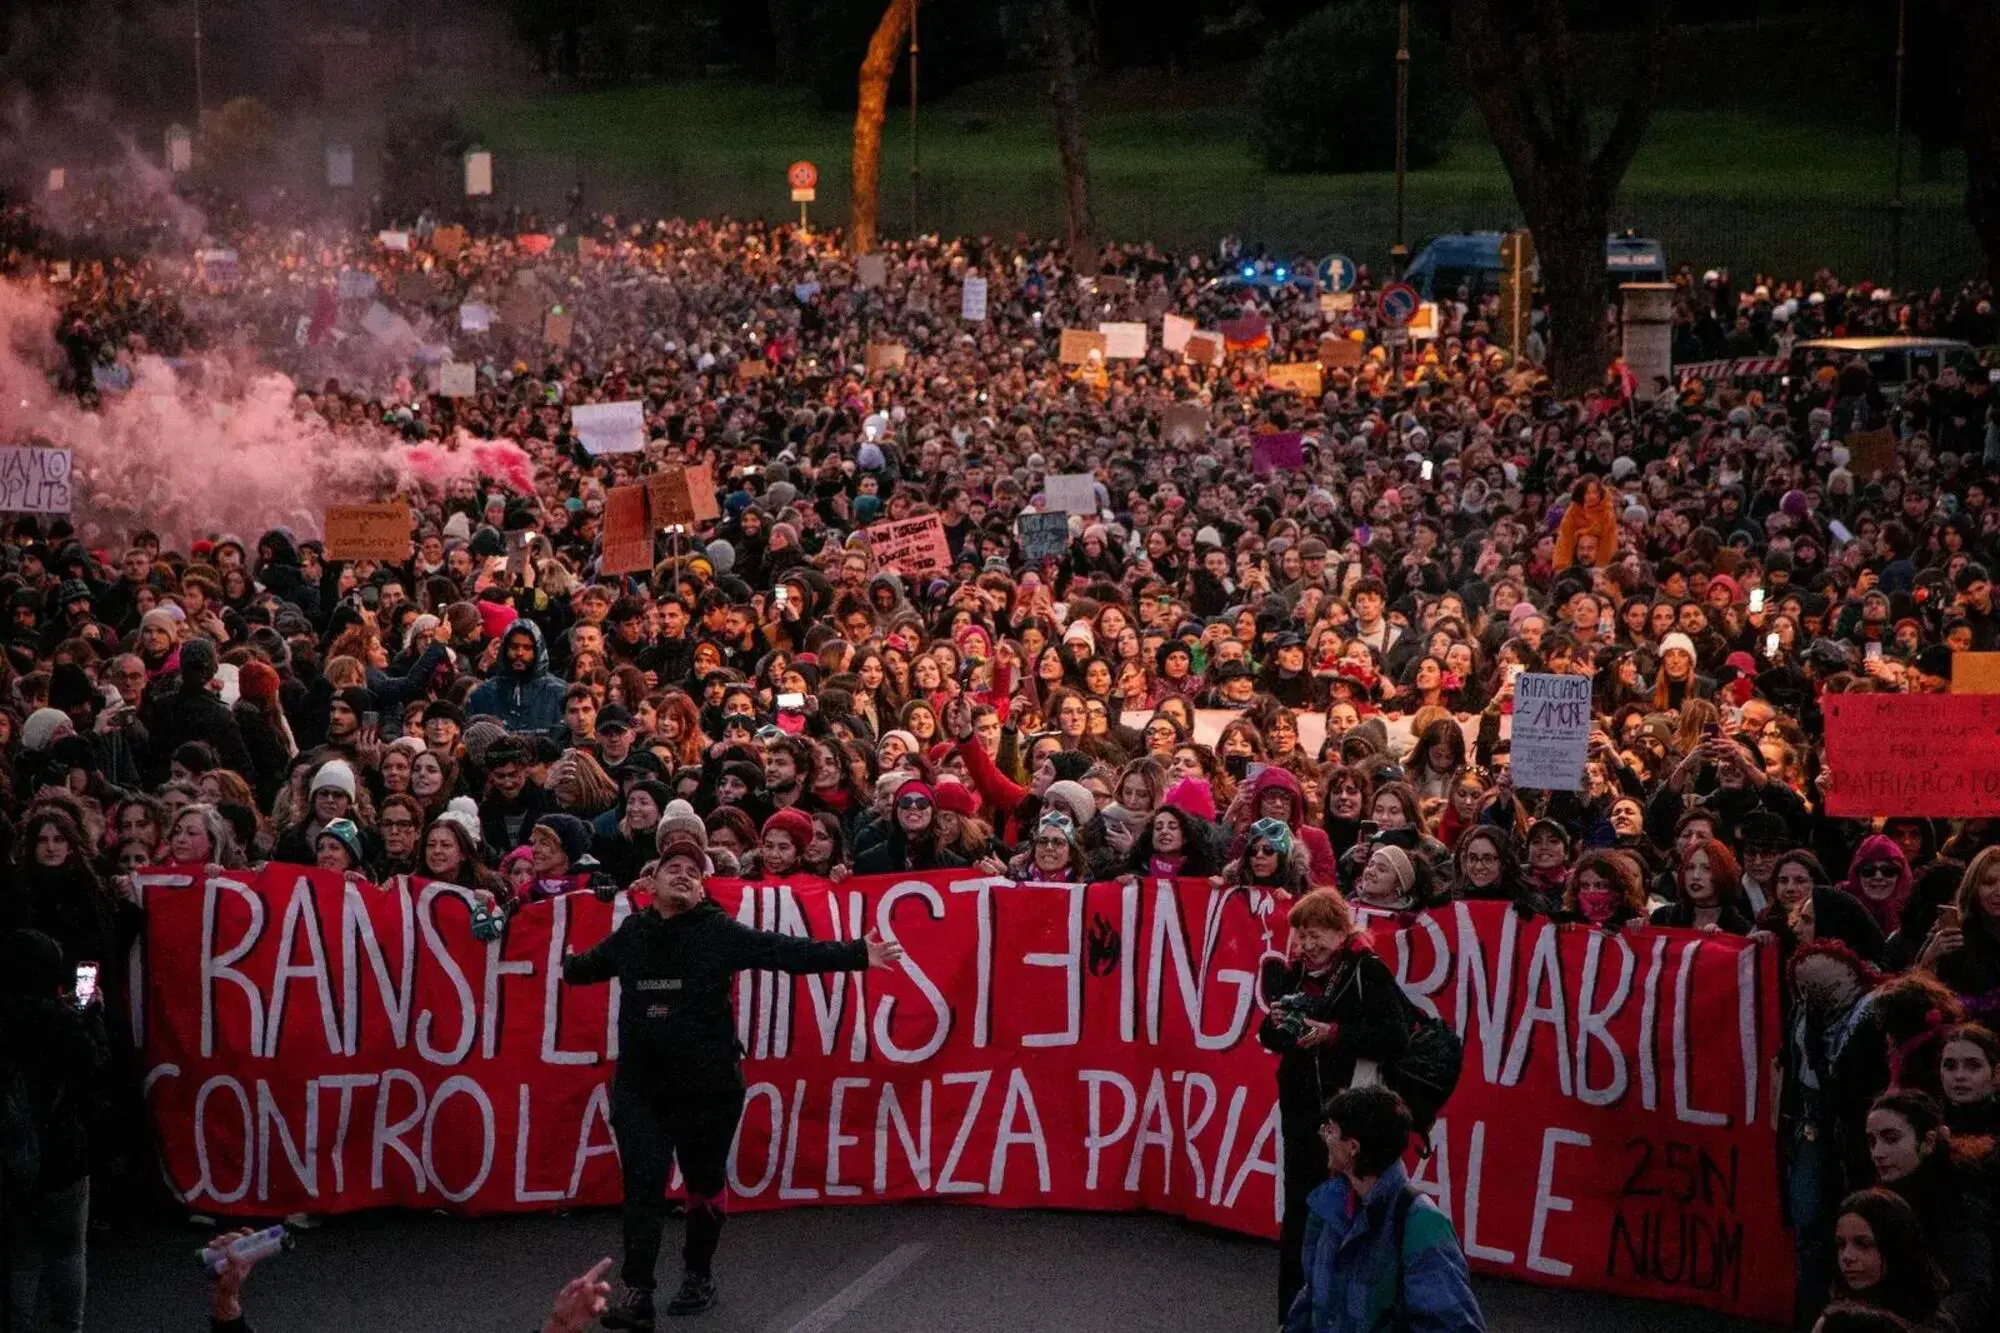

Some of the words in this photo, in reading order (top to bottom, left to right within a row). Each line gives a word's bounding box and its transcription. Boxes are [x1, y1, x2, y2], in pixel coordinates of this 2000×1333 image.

[1520, 677, 1589, 700] RIFACCIAMO
[1623, 1137, 1739, 1212] 25N
[1606, 1209, 1744, 1301] NUDM
